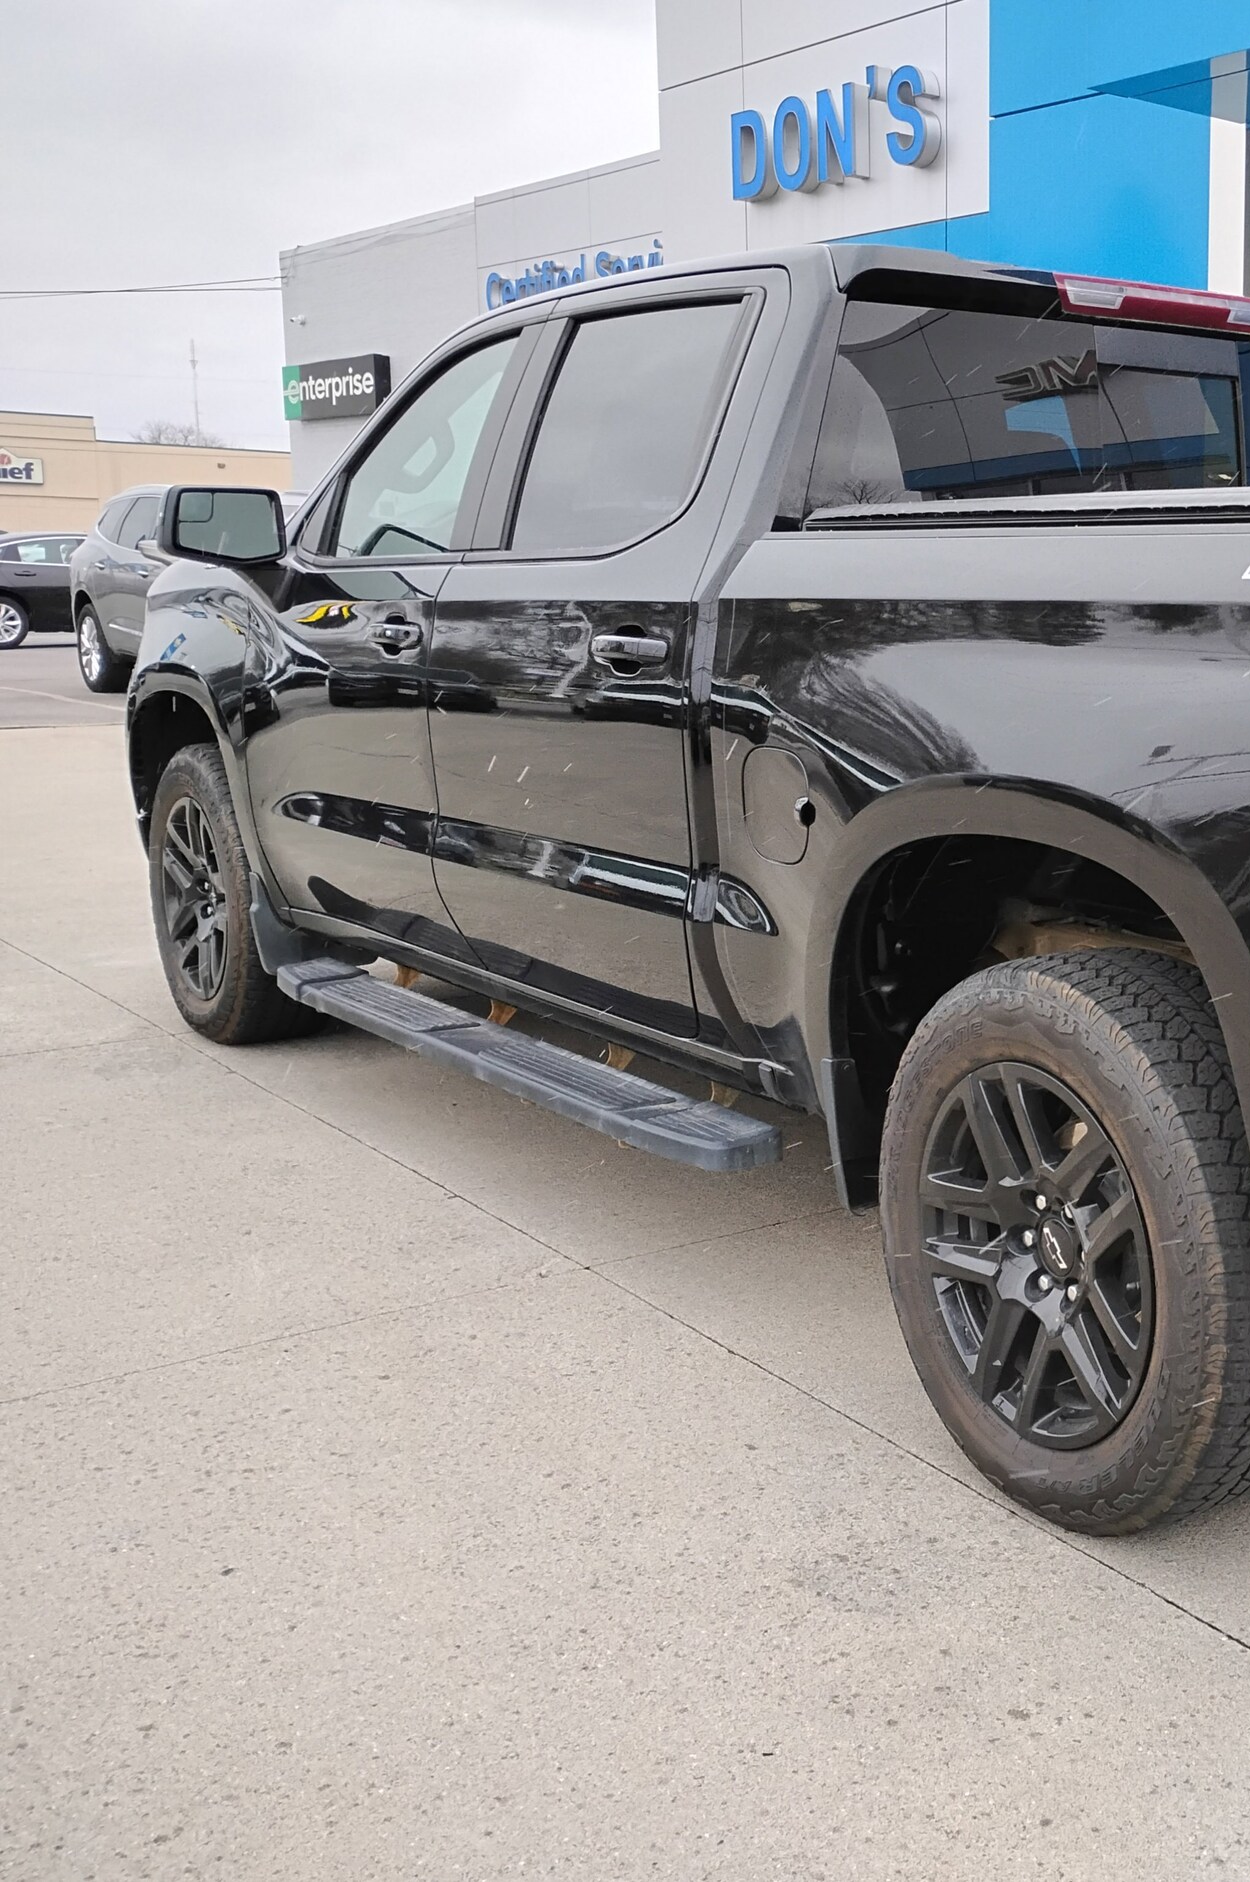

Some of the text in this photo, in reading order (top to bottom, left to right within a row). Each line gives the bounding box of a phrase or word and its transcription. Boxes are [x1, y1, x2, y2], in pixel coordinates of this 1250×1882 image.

[731, 64, 932, 201] DON'S
[283, 366, 374, 406] enterprise
[0, 462, 34, 480] ief
